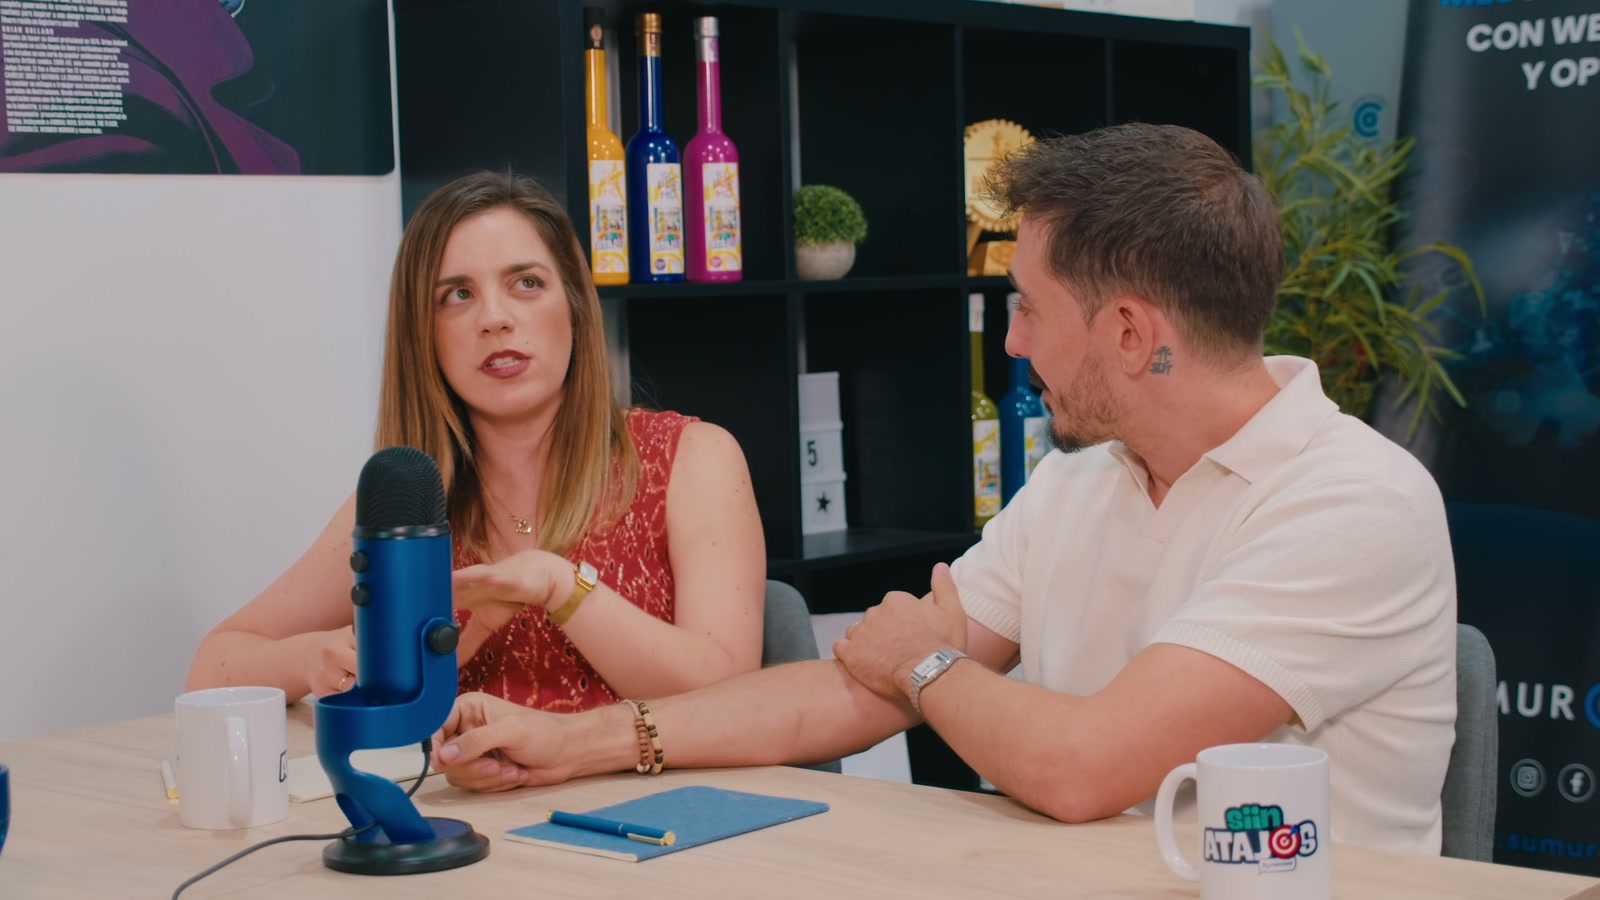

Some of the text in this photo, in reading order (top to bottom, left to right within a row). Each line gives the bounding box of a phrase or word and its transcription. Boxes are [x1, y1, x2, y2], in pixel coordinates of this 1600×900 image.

[1466, 18, 1545, 53] CON
[1521, 61, 1546, 91] Y
[806, 440, 818, 466] 5
[1225, 803, 1284, 831] siin
[1203, 820, 1319, 864] ATAJOS
